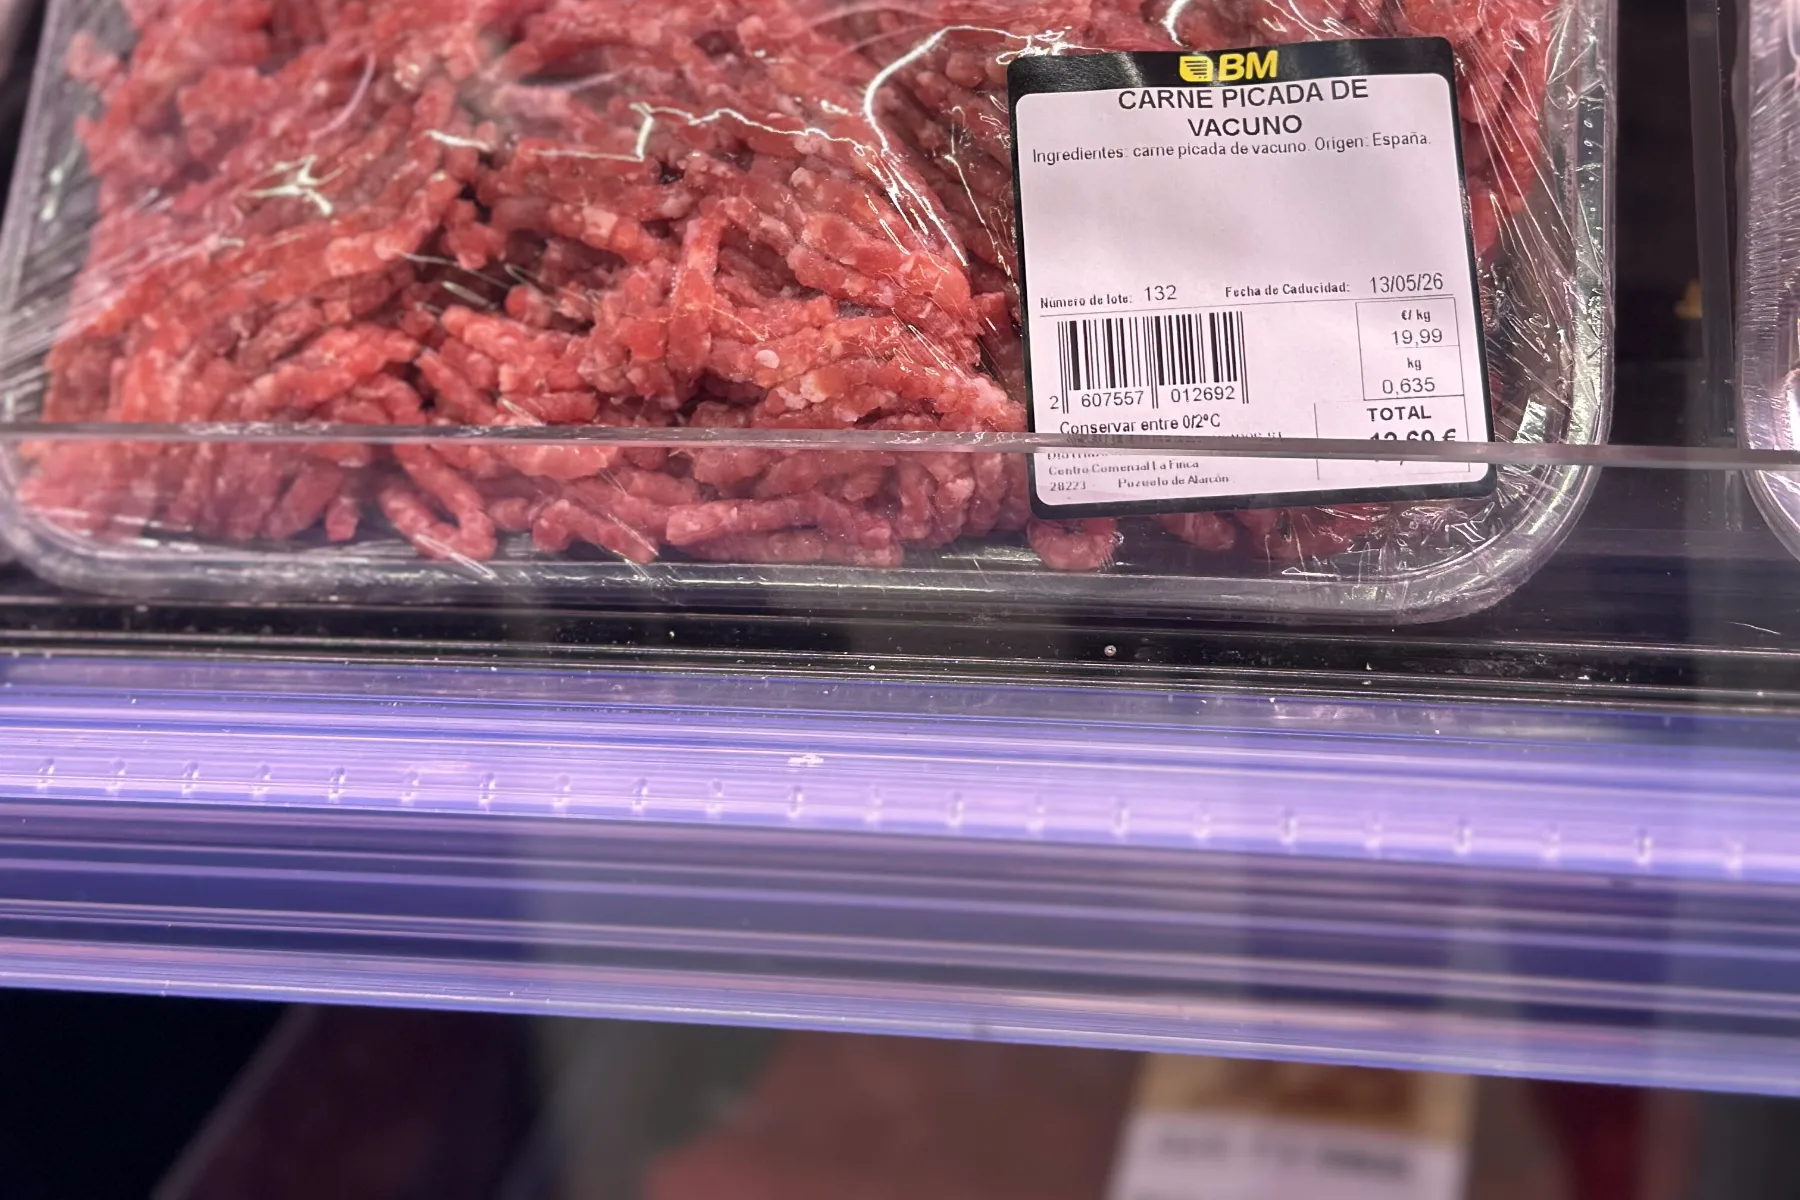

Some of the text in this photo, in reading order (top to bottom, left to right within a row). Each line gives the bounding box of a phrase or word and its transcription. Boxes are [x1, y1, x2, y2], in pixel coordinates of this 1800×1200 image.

[1218, 50, 1278, 81] BM
[1118, 78, 1369, 110] CARNE PICADA DE
[1187, 114, 1302, 138] VACUNO
[1033, 146, 1129, 166] Ingredientes:
[1133, 144, 1174, 157] carne
[1178, 141, 1226, 159] picada
[1231, 141, 1249, 155] de
[1315, 136, 1369, 153] Origen:
[1372, 131, 1432, 149] España.
[1089, 294, 1103, 306] de
[1106, 293, 1132, 305] lote:
[1144, 284, 1178, 301] 132
[1225, 285, 1261, 298] Fecha
[1264, 284, 1279, 296] de
[1282, 282, 1351, 295] Caducidad:
[1369, 273, 1444, 294] 13/05/26
[1416, 309, 1431, 322] kg
[1391, 328, 1443, 348] 19,99
[1407, 357, 1422, 371] kg
[1382, 377, 1435, 396] 0,635
[1049, 386, 1235, 410] 2 607557 012692
[1367, 405, 1432, 422] TOTAL
[1060, 422, 1136, 434] Conservar
[1141, 418, 1179, 430] entre
[1171, 475, 1185, 485] de
